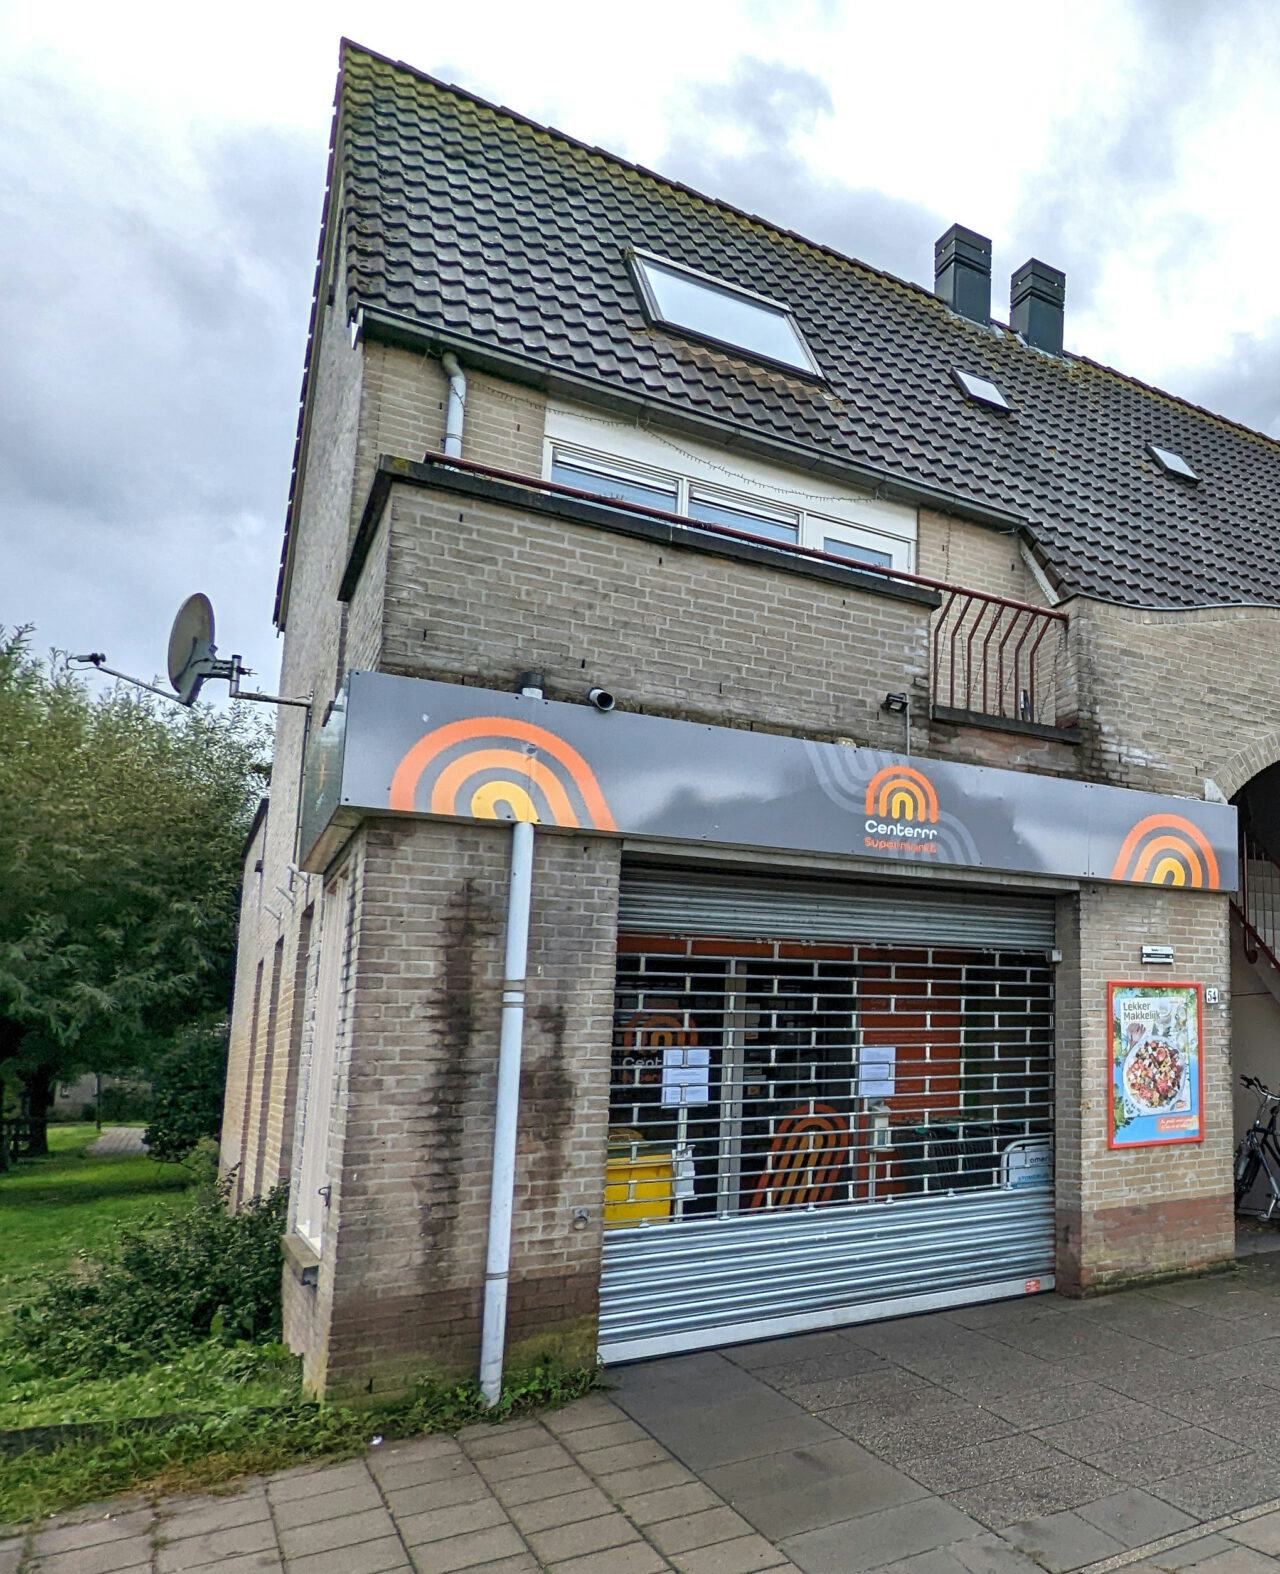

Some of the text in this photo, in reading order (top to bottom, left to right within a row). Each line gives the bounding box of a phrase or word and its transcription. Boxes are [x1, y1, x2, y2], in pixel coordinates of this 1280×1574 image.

[865, 820, 937, 839] Centerrr
[1207, 989, 1217, 1002] 54
[1123, 1002, 1151, 1011] Lekker
[1123, 1011, 1160, 1021] Makkelijk
